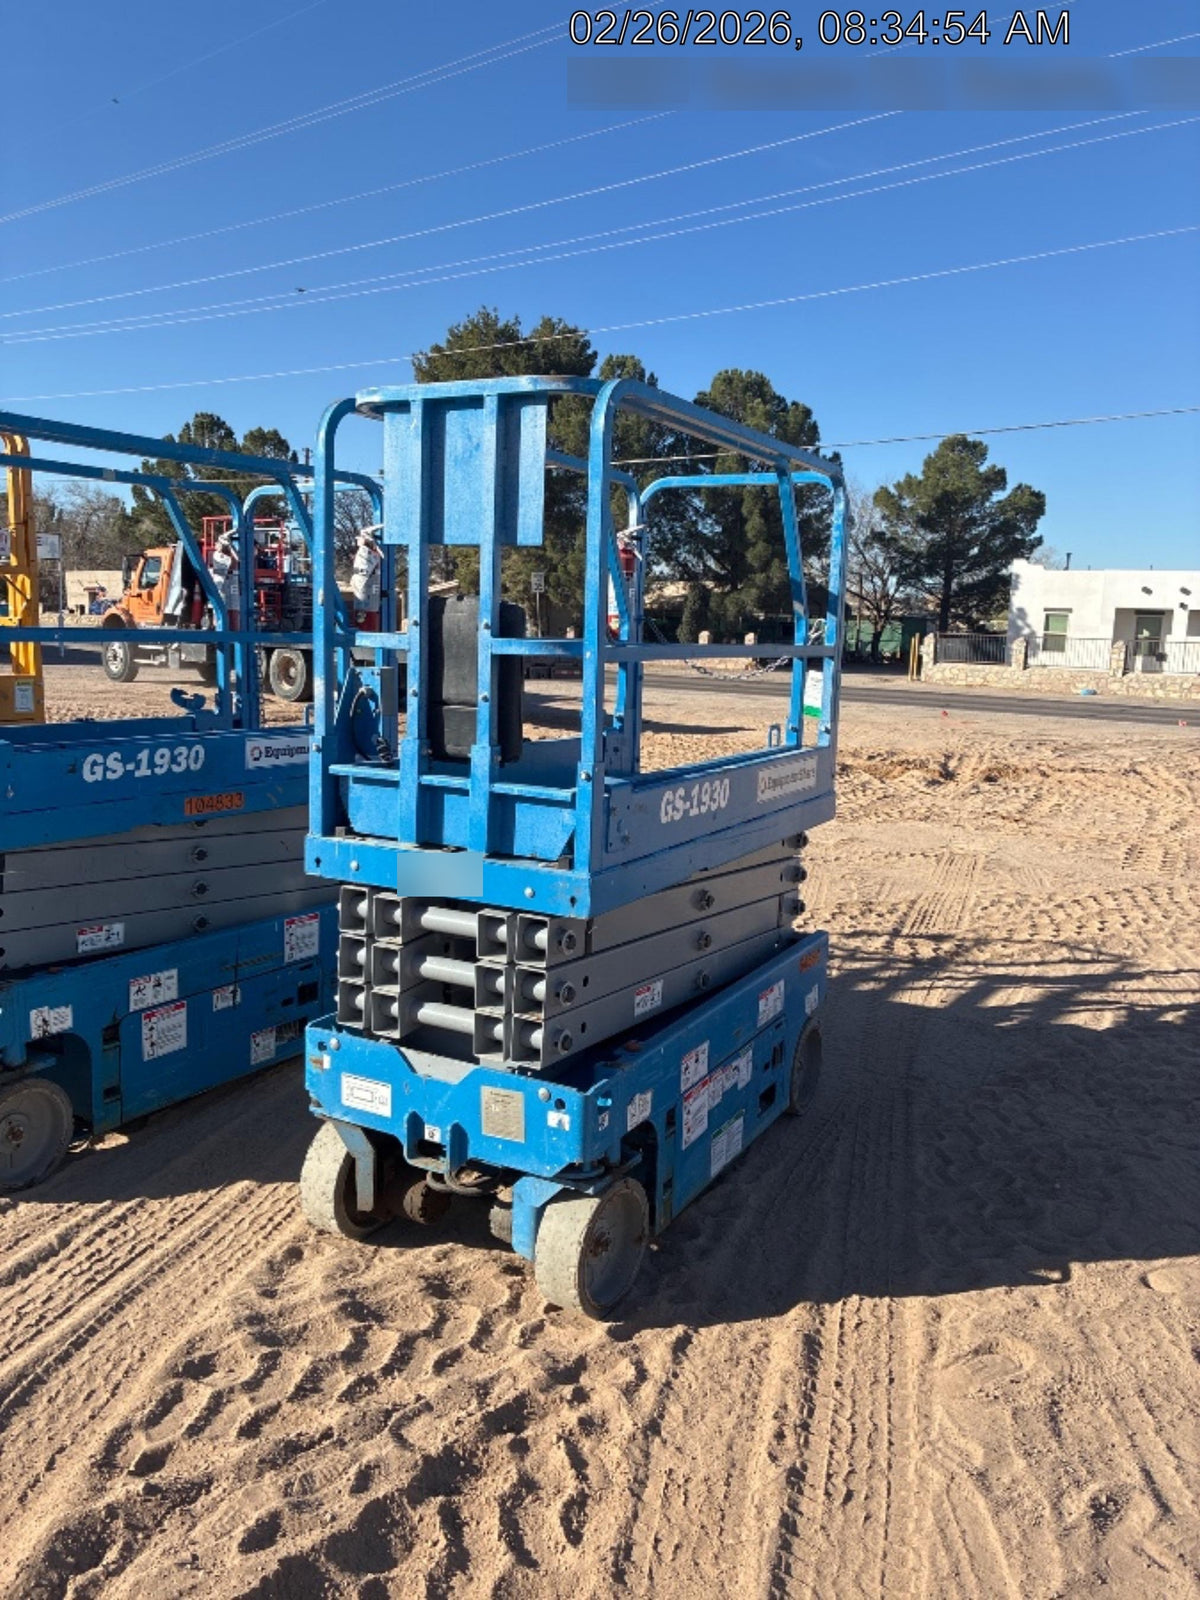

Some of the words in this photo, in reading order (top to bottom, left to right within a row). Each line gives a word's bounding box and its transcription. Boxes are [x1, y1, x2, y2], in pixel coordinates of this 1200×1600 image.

[82, 744, 206, 783] GS-1930
[185, 792, 243, 815] 104833
[660, 777, 731, 824] GS-1930
